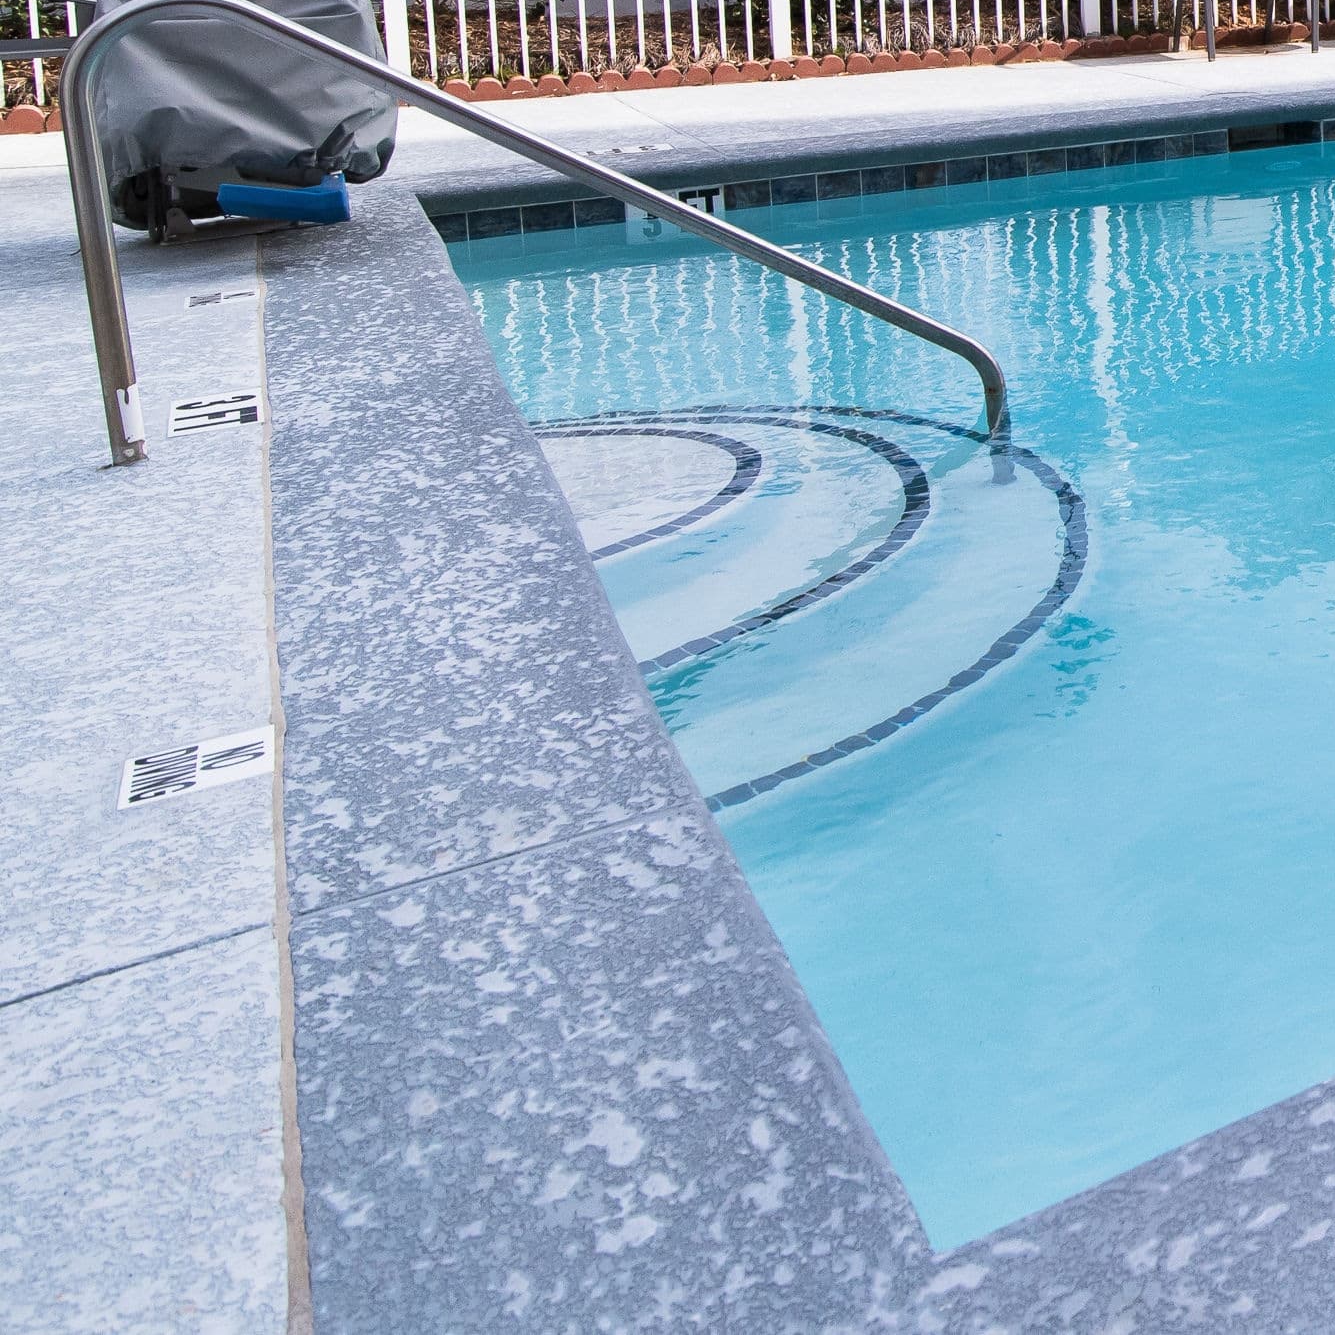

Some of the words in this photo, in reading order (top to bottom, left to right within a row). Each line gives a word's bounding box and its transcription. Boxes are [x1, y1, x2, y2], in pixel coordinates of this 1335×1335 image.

[175, 394, 257, 410] 3
[173, 405, 258, 432] FT
[200, 740, 265, 771] NO
[128, 745, 199, 804] DIVING
